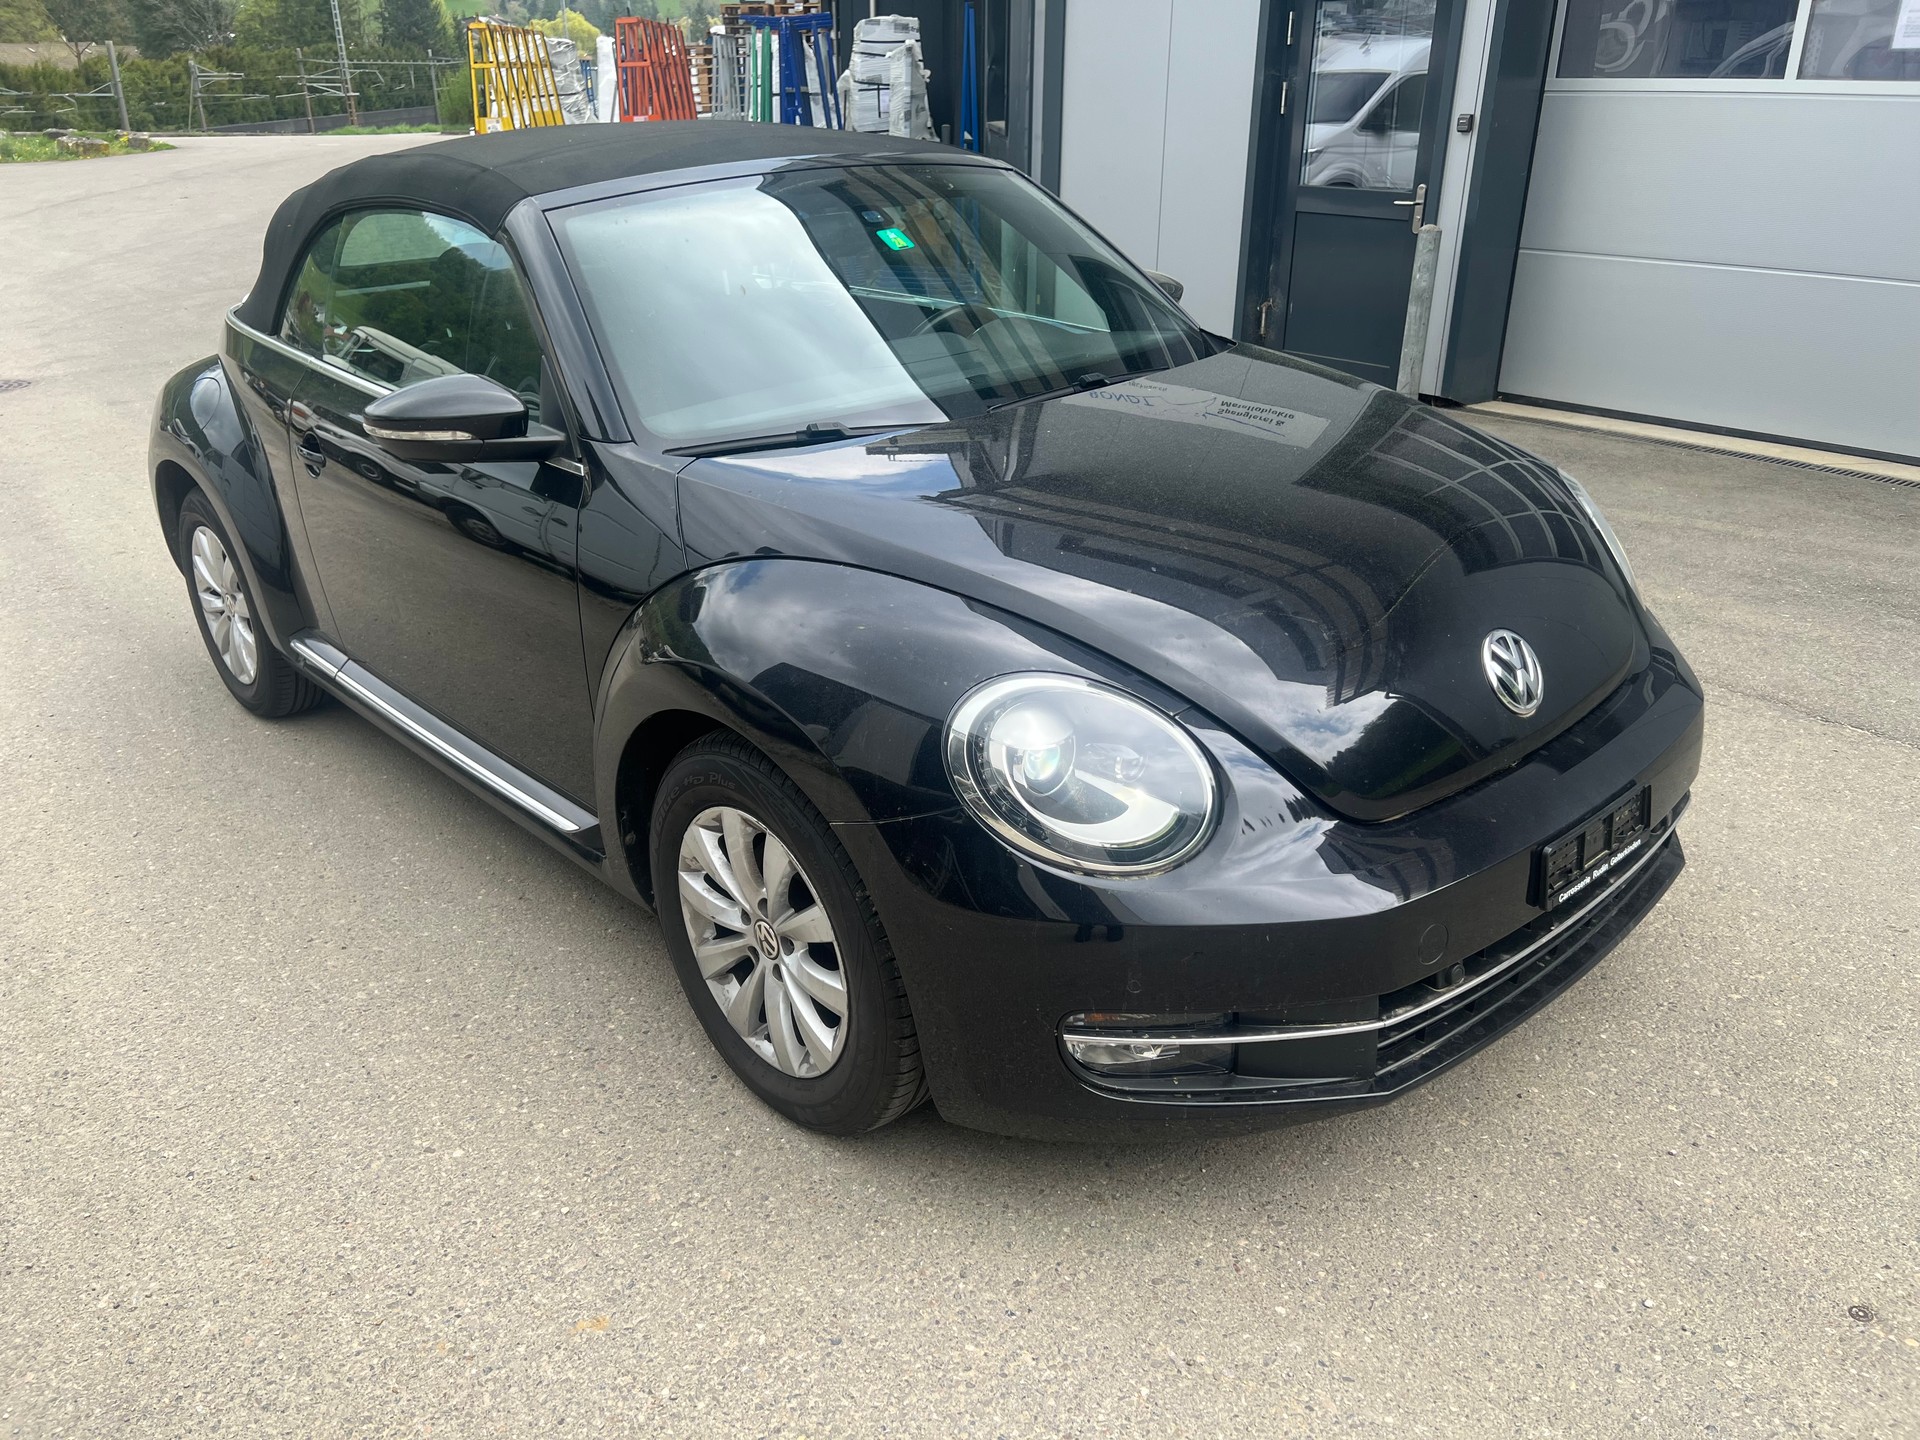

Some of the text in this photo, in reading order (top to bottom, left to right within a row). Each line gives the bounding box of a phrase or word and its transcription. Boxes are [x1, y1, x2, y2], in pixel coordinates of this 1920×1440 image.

[708, 771, 736, 790] Plus
[1559, 876, 1591, 902] Carrosserie
[1592, 863, 1609, 880] Rudin
